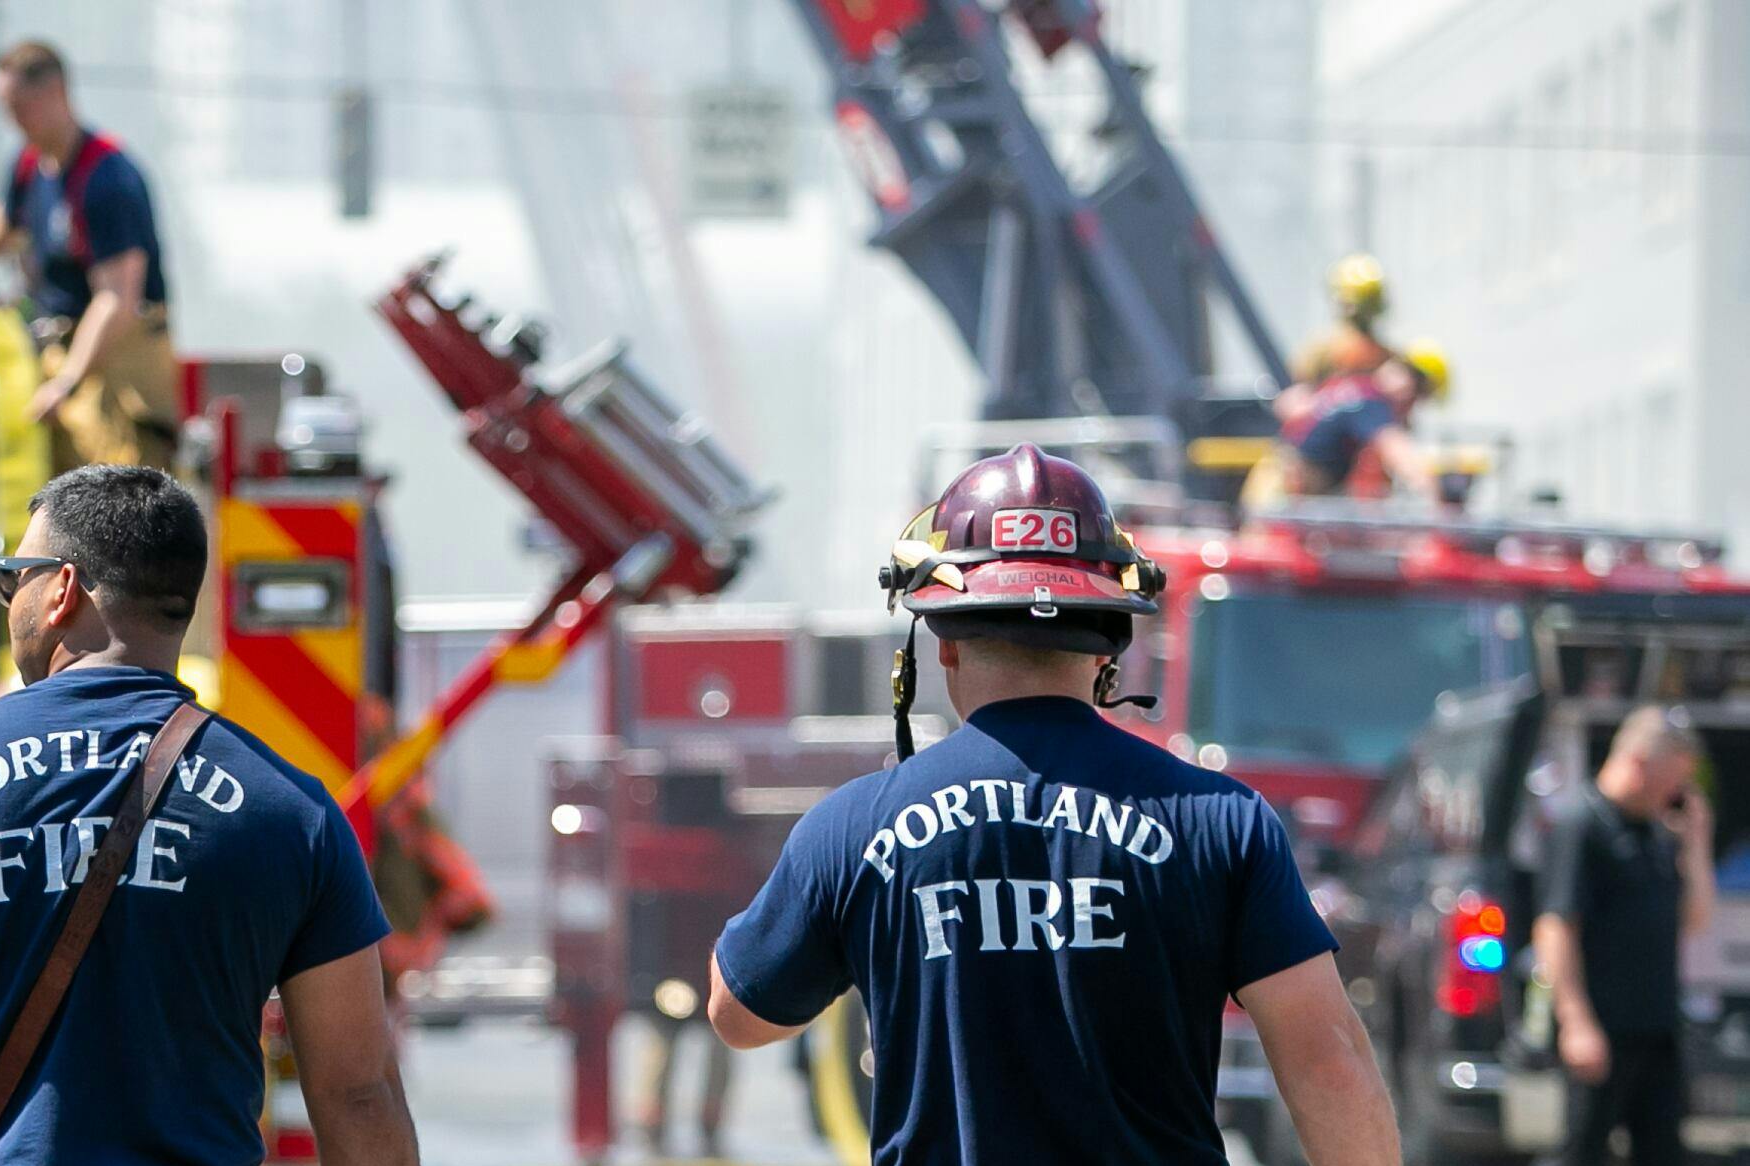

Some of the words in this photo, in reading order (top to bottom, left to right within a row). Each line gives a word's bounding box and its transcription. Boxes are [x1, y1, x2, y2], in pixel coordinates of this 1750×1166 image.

[995, 513, 1074, 547] E26
[1001, 571, 1080, 586] WEICHAL
[863, 779, 1173, 884] PORTLAND
[912, 877, 1126, 961] FIRE
